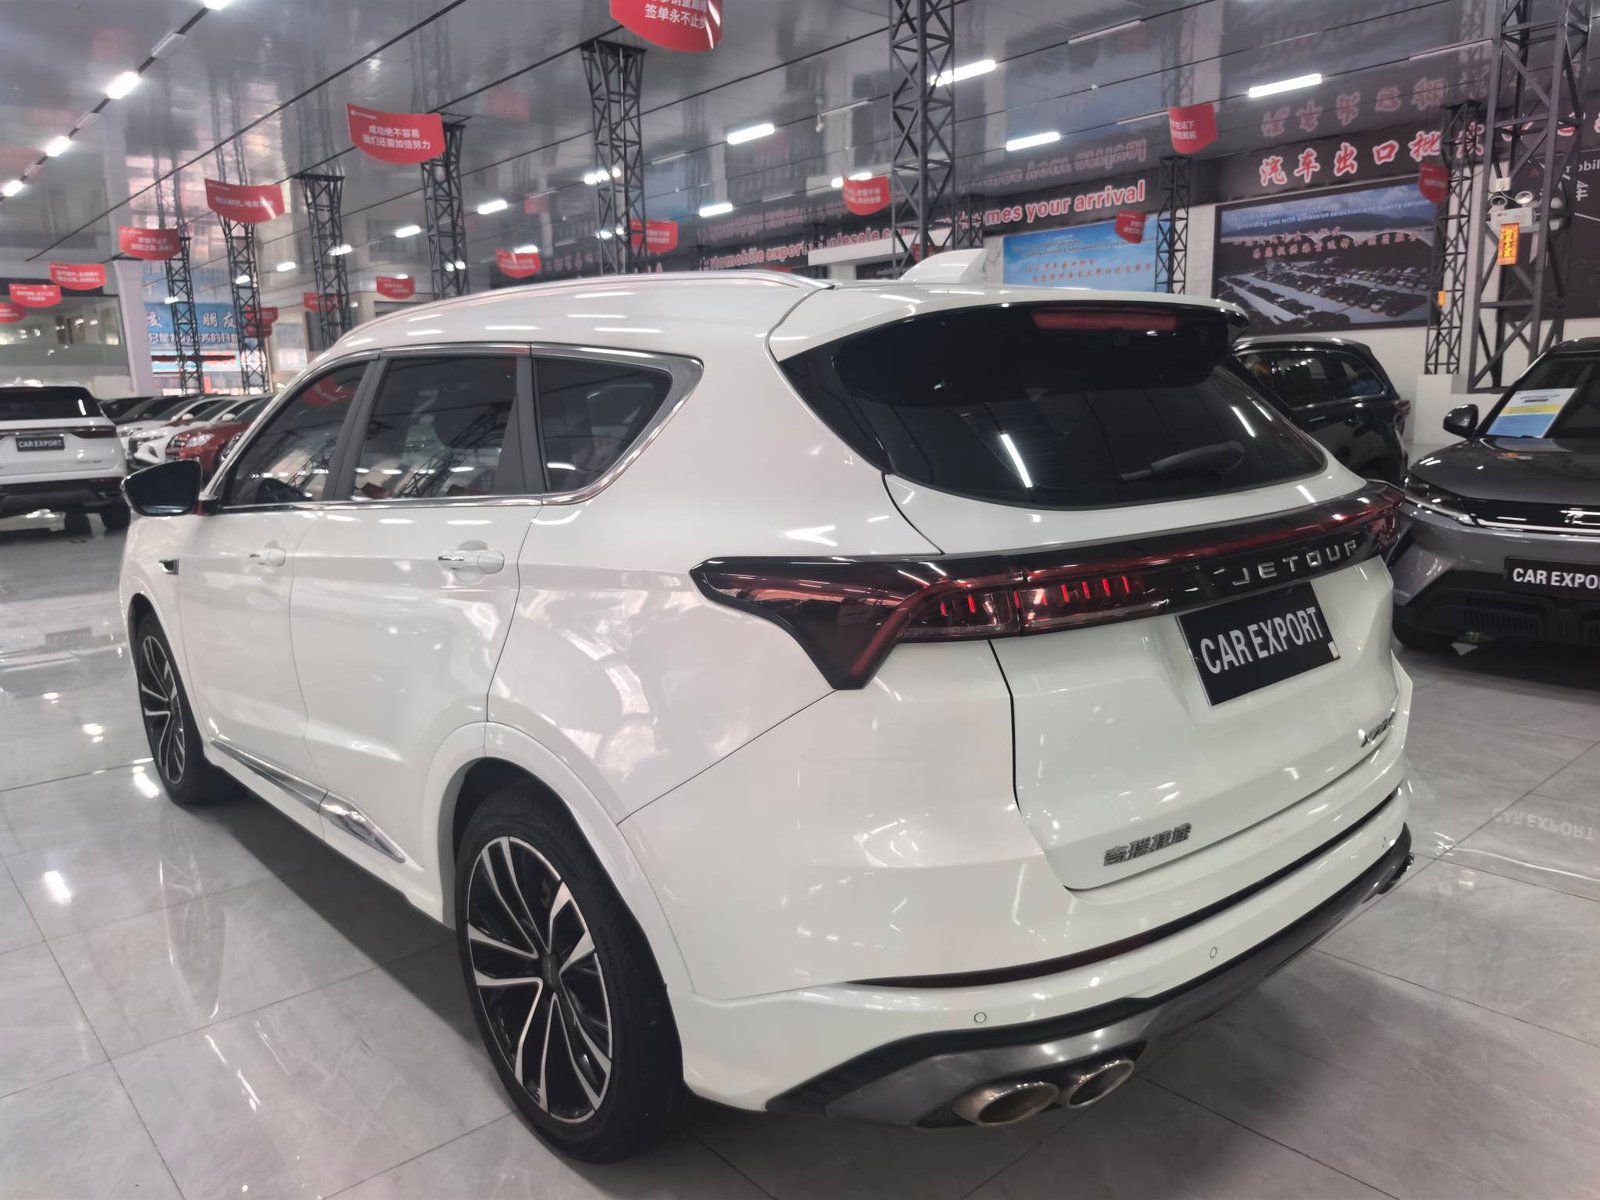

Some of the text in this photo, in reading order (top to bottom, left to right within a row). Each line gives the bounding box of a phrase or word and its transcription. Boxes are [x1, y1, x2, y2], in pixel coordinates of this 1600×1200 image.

[1026, 196, 1071, 223] your
[1074, 180, 1146, 211] arrival
[1268, 217, 1281, 227] you
[1281, 215, 1296, 224] with
[19, 439, 62, 449] CAR EXPORT
[1232, 539, 1357, 586] JETOUR
[1512, 567, 1600, 590] CAR EXPO
[1200, 606, 1324, 674] CAR EXPORT
